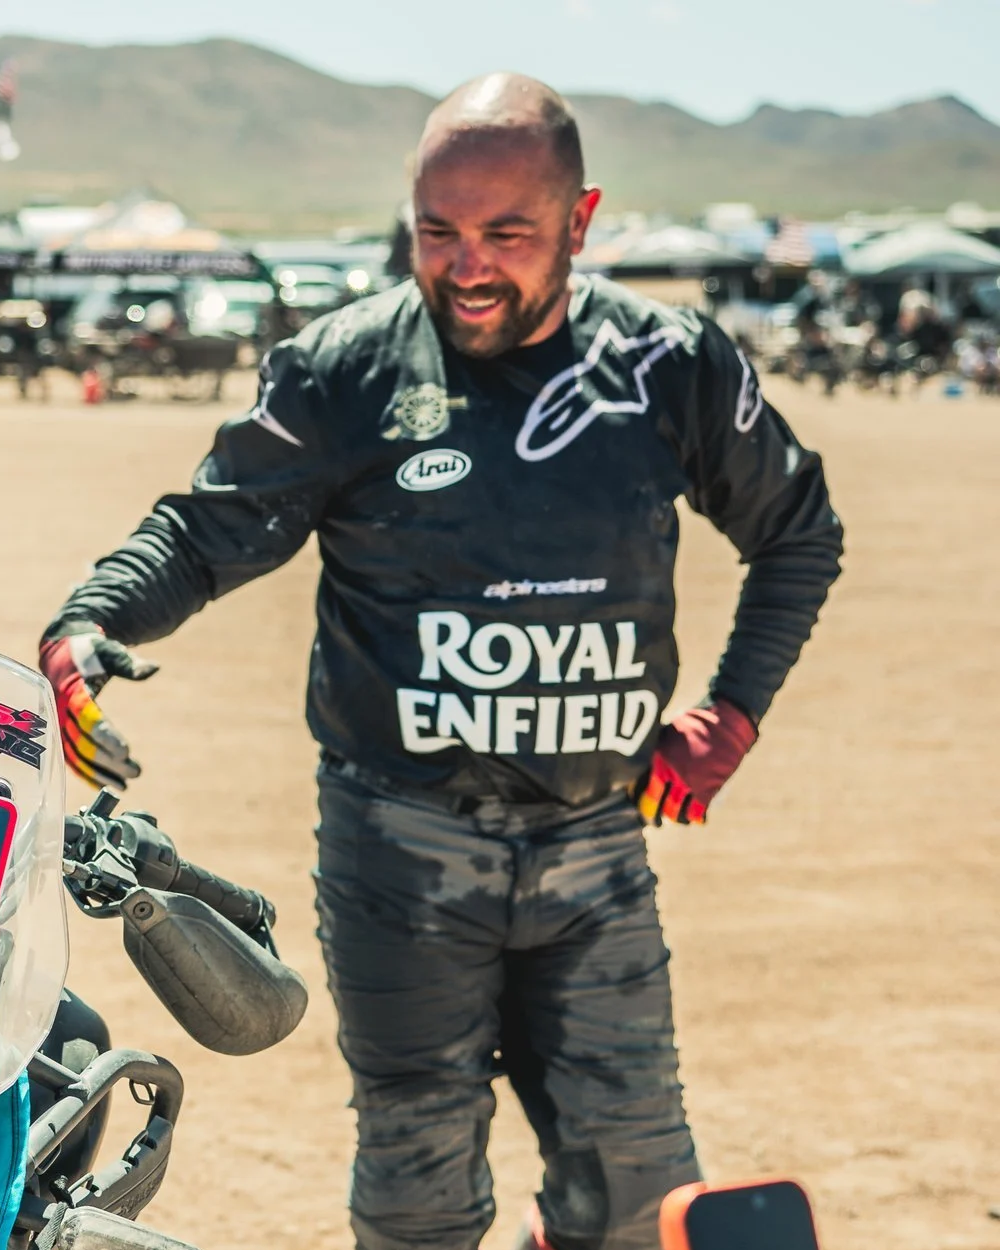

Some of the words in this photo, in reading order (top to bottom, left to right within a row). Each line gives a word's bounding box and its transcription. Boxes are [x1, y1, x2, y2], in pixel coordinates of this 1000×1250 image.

[410, 456, 458, 480] Arai
[483, 577, 607, 600] alpinestars
[417, 611, 647, 690] ROYAL
[396, 688, 659, 757] ENFIELD
